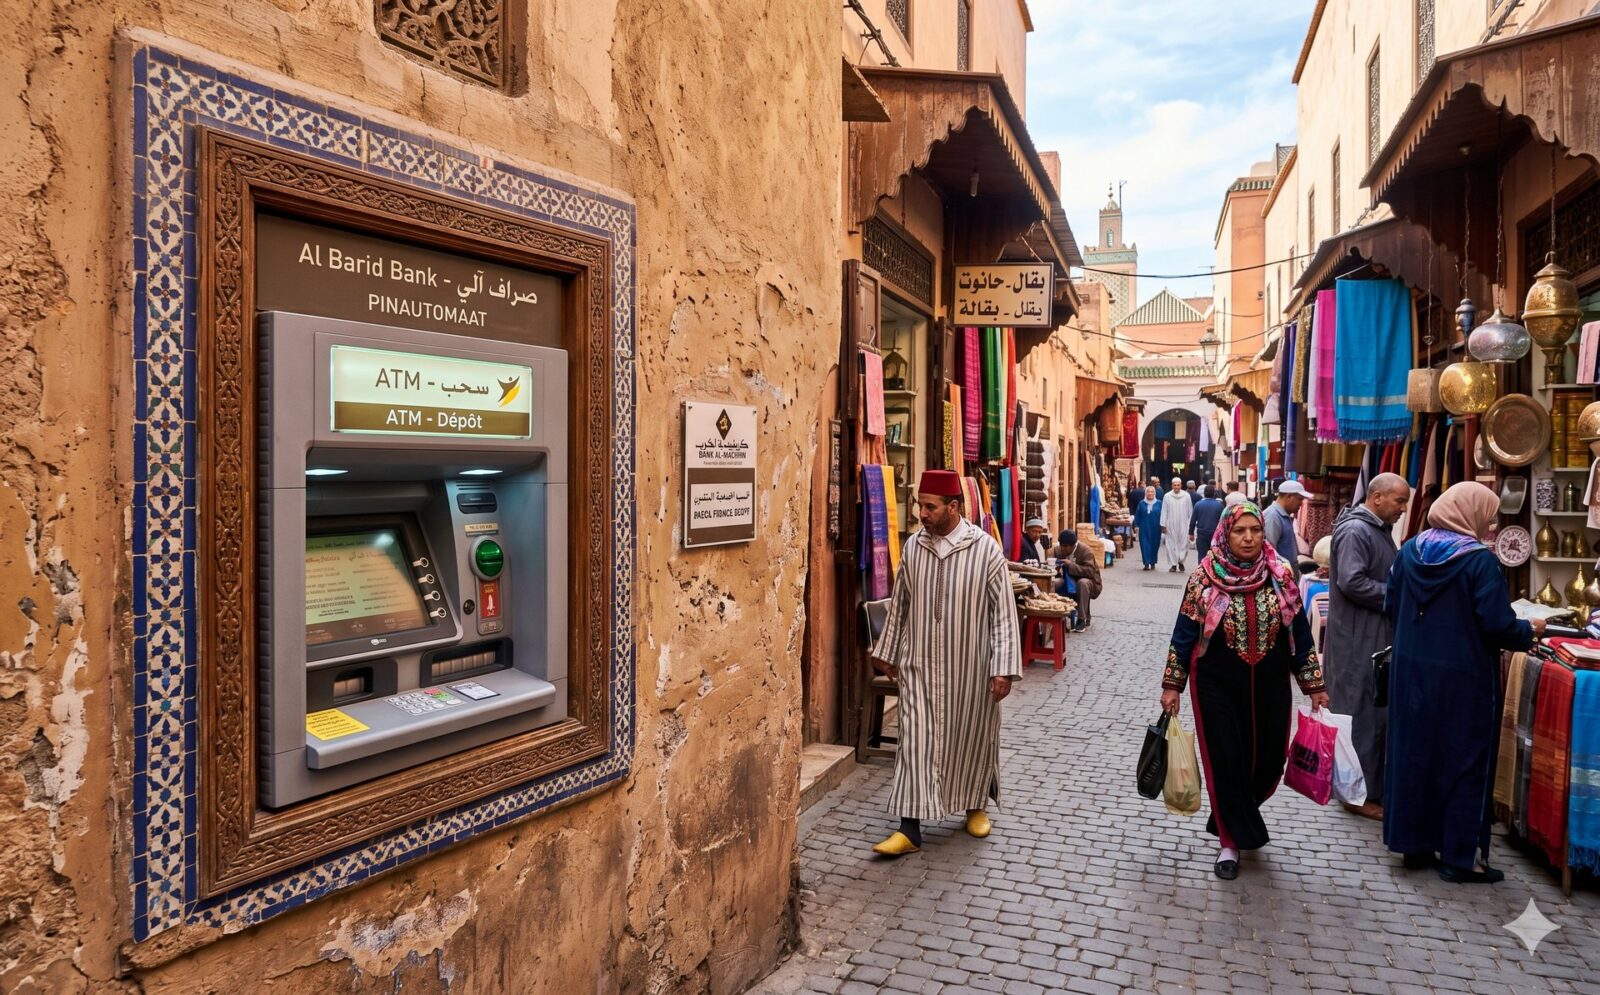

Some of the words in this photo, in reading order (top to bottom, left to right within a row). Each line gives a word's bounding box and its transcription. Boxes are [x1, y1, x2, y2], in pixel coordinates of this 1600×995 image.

[298, 243, 322, 267] Al
[329, 248, 383, 278] Barid
[390, 260, 438, 288] Bank
[457, 270, 485, 304] آلي
[959, 271, 1004, 294] حانوت
[1012, 271, 1045, 294] بقال
[488, 278, 538, 306] صراف
[368, 293, 487, 327] PINAUTOMAAT
[959, 299, 999, 321] بقالة
[375, 367, 420, 390] ATM
[441, 382, 489, 398] سحب
[386, 409, 422, 426] ATM
[437, 411, 483, 431] Dépôt
[698, 450, 714, 459] BANK
